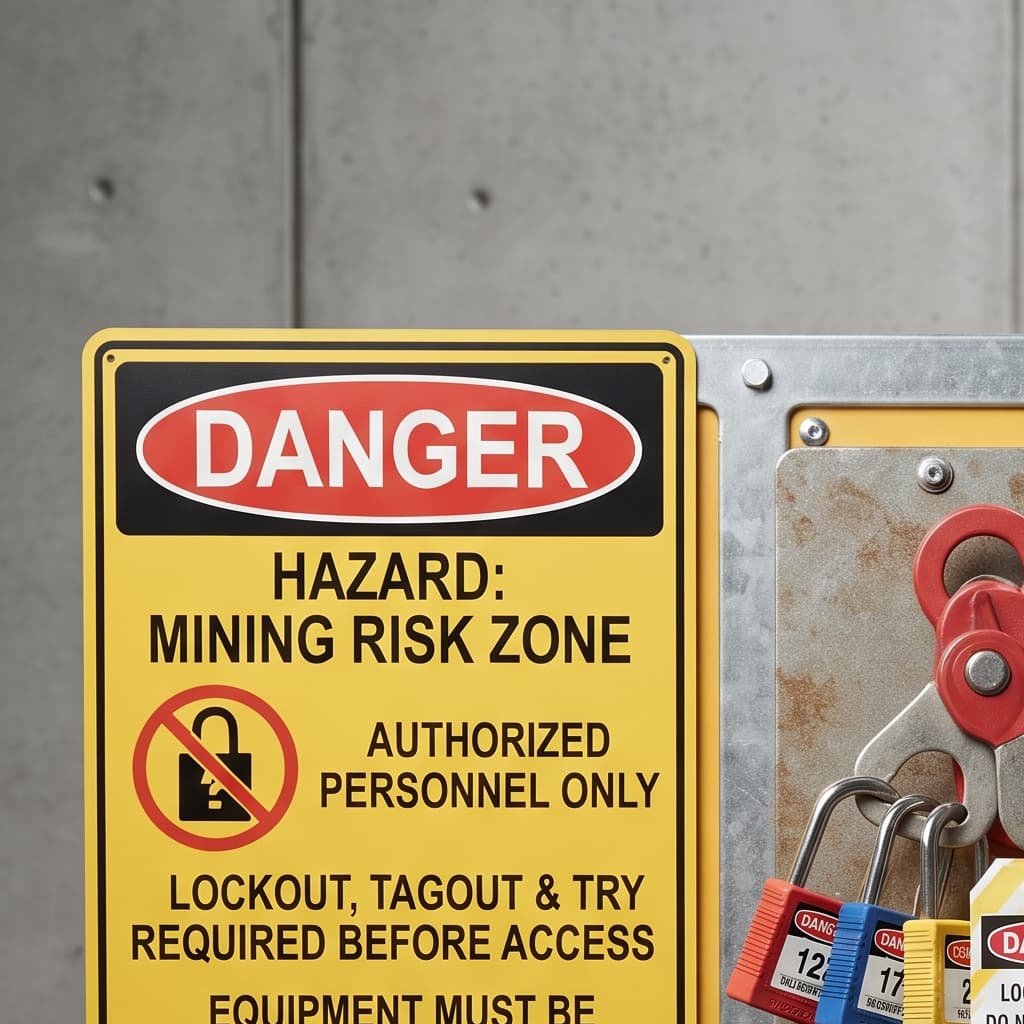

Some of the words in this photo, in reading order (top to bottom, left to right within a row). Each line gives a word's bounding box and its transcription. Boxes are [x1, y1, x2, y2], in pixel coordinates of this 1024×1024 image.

[195, 409, 589, 489] DANGER
[275, 552, 503, 600] HAZARD:
[151, 615, 333, 664] MINING
[354, 615, 474, 664] RISK
[490, 615, 630, 664] ZONE
[367, 722, 609, 758] AUTHORIZED
[321, 772, 548, 808] PERSONNEL
[562, 772, 659, 808] ONLY
[171, 874, 356, 917] LOCKOUT,
[370, 875, 522, 910] TAGOUT
[536, 874, 560, 910] &
[573, 875, 644, 910] TRY
[132, 924, 325, 963] REQUIRED
[340, 924, 490, 960] BEFORE
[501, 925, 654, 960] ACCESS
